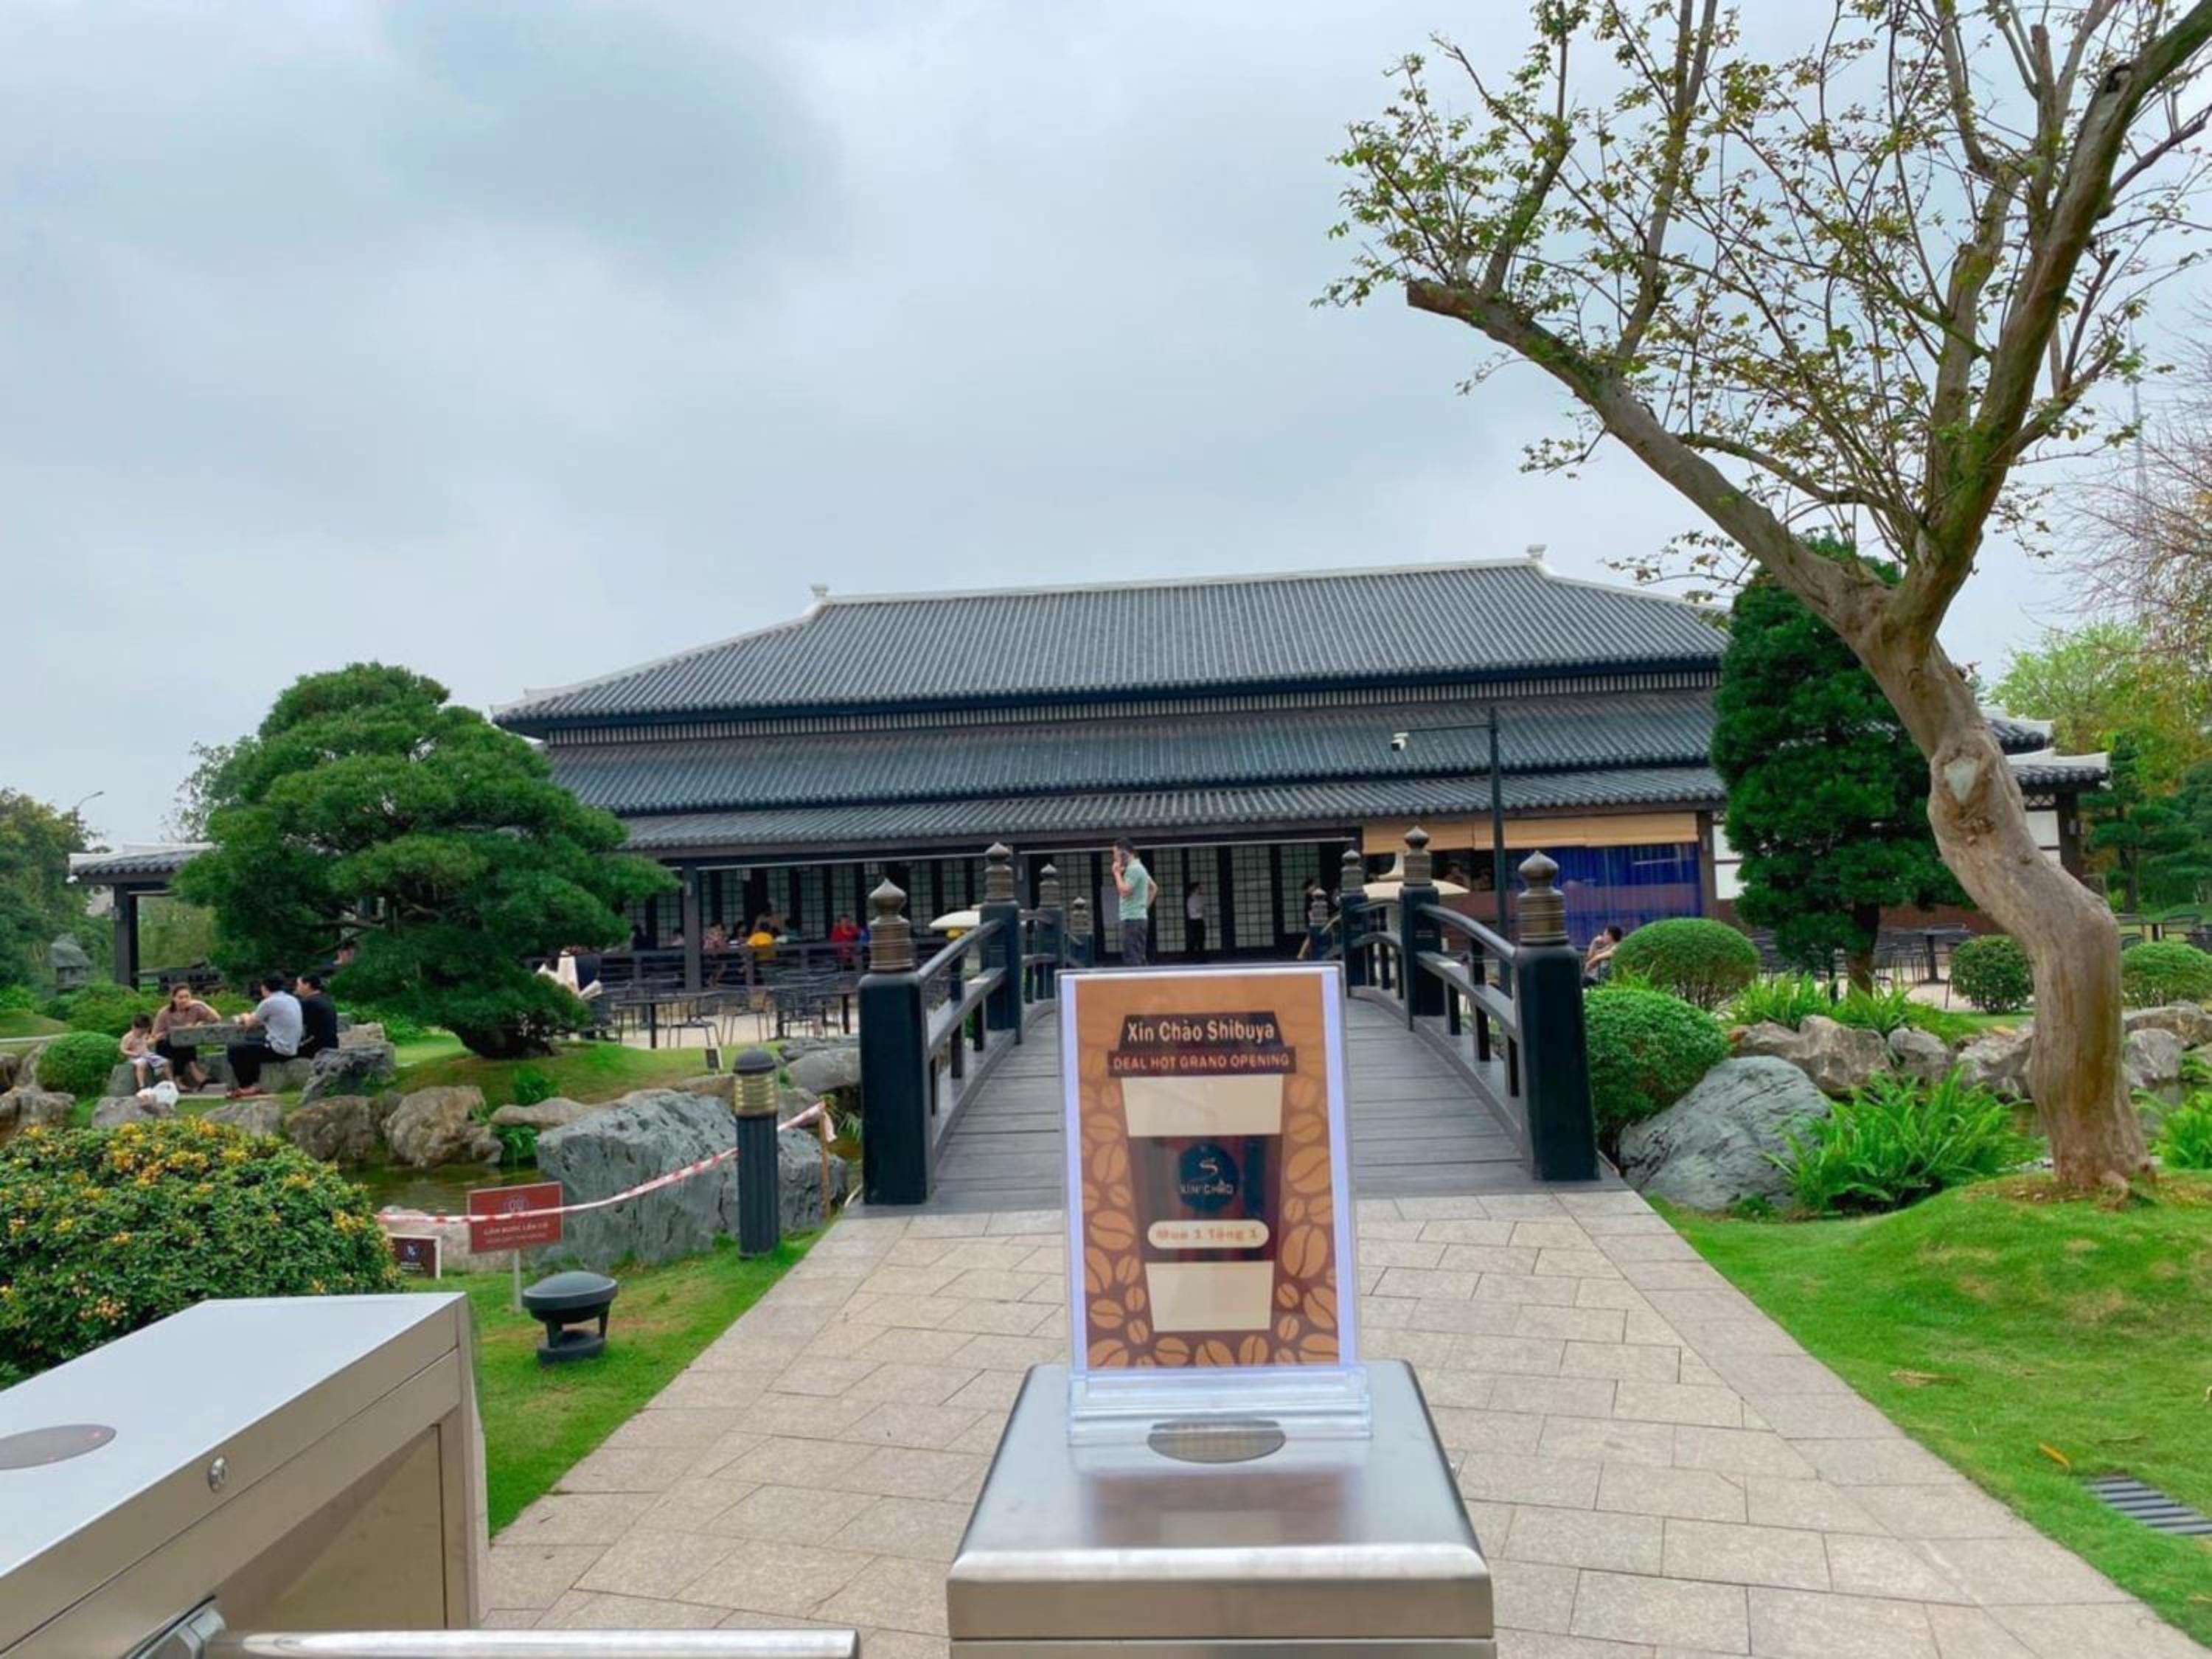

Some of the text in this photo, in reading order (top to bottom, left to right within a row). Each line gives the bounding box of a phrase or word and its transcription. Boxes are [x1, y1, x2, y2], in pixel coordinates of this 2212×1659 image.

[1127, 1022, 1155, 1042] Xin
[1206, 1019, 1275, 1043] Shibuya
[1113, 1057, 1147, 1069] DEAL
[1150, 1056, 1177, 1068] HOT
[1229, 1053, 1290, 1068] OPENING
